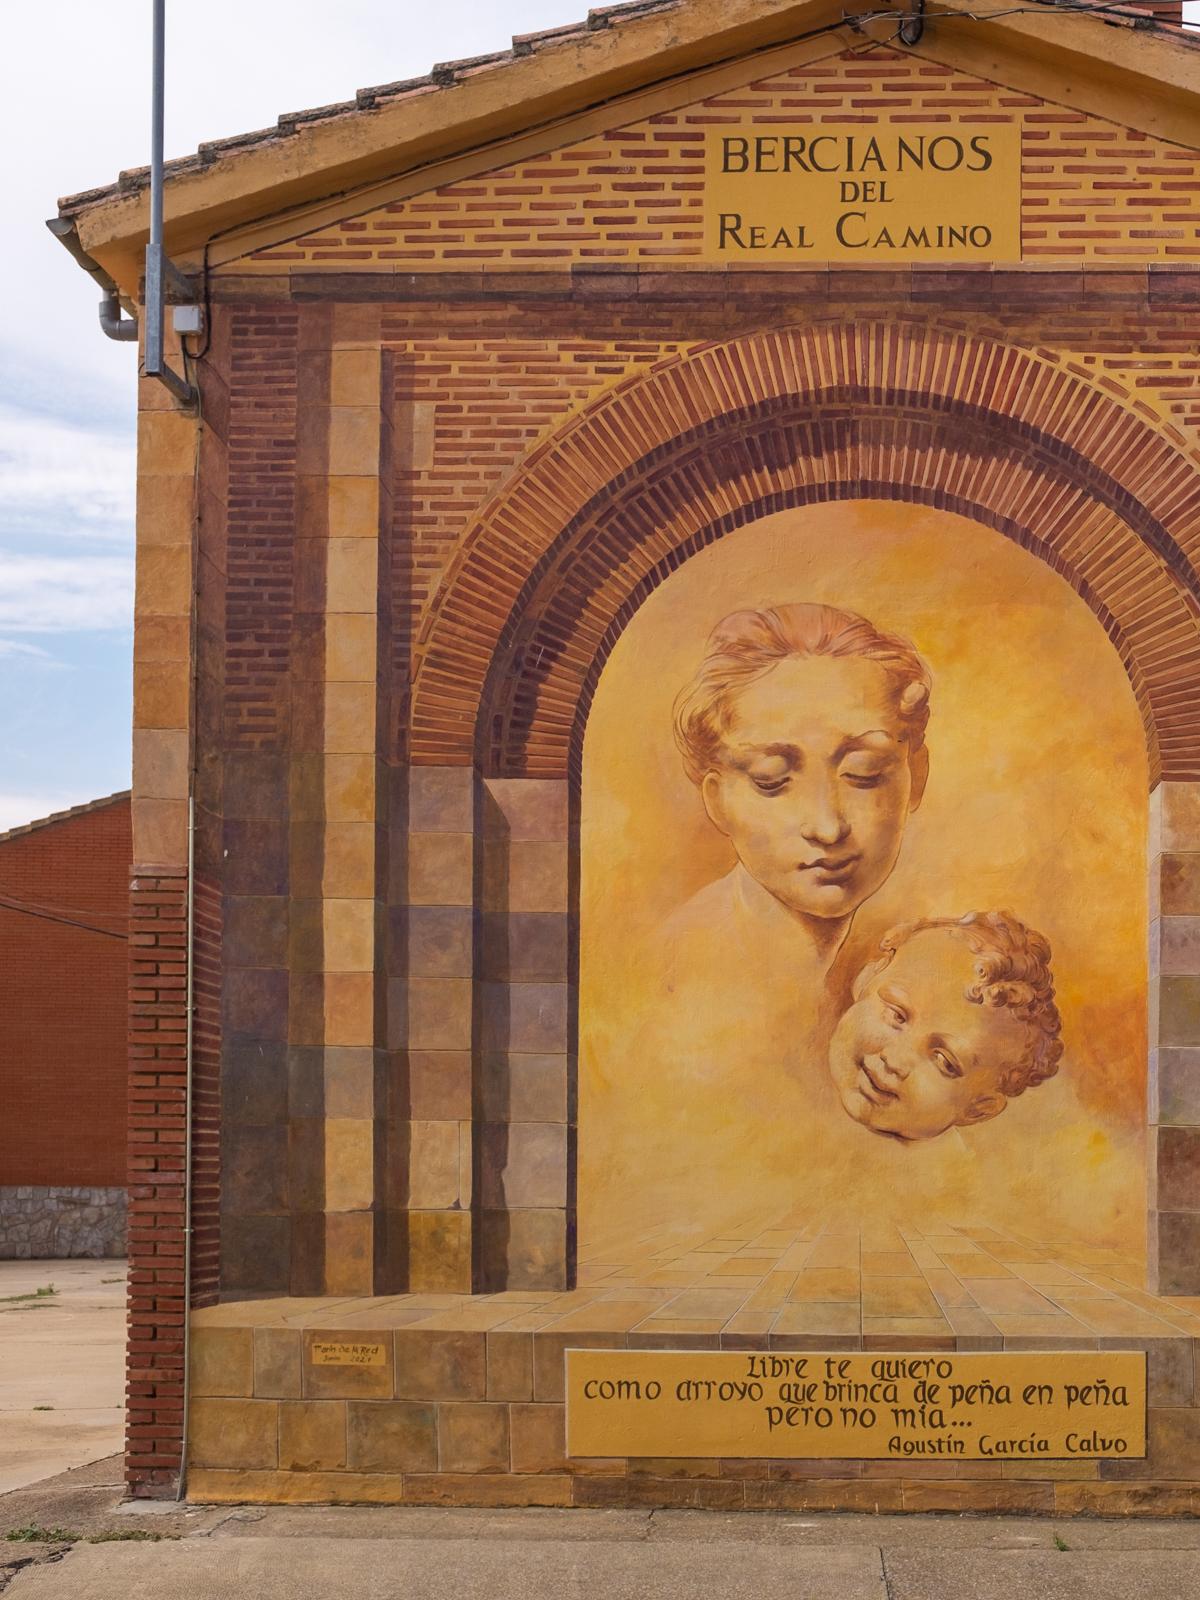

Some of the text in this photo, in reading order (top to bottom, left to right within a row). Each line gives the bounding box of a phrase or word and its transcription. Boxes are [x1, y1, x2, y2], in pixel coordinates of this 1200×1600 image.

[721, 135, 992, 173] BERCIANOS
[840, 180, 895, 203] DEL
[718, 211, 992, 249] REAL CAMINO
[746, 1355, 953, 1383] Libre te quiero
[584, 1379, 1130, 1410] como arroyo que brinca de peña en peña
[765, 1405, 833, 1432] pero
[839, 1406, 876, 1429] no
[888, 1430, 1128, 1456] Agustín García Calvo
